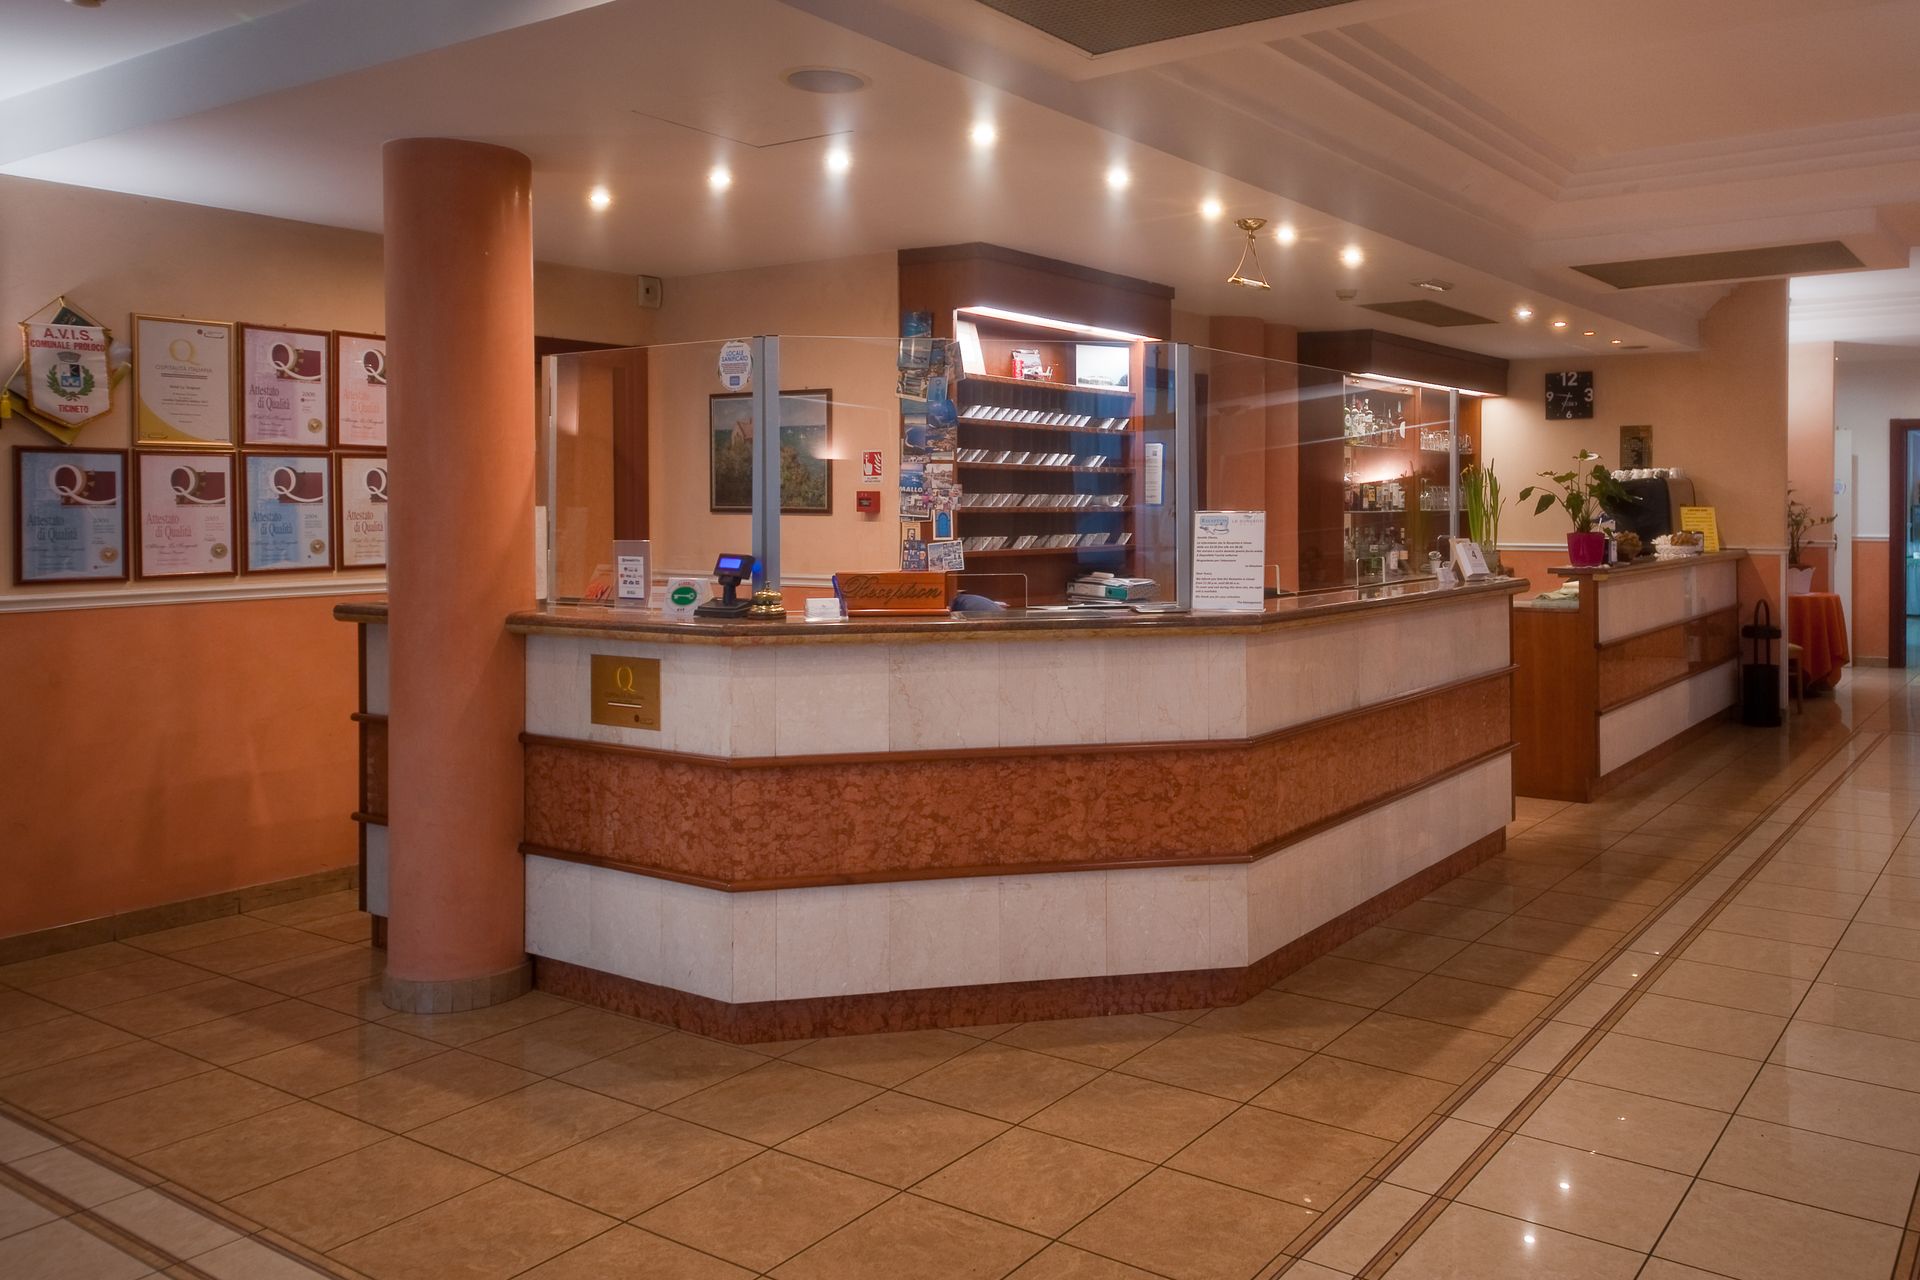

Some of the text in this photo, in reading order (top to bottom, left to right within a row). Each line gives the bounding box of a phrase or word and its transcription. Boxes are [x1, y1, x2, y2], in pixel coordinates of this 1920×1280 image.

[44, 328, 93, 341] A.V.I.S.
[30, 339, 71, 350] COMUNALE
[1560, 372, 1578, 386] 12
[1546, 391, 1554, 402] 9
[1584, 388, 1593, 402] 3
[1566, 410, 1572, 419] 6
[1472, 550, 1478, 560] 4
[843, 575, 942, 605] Reception
